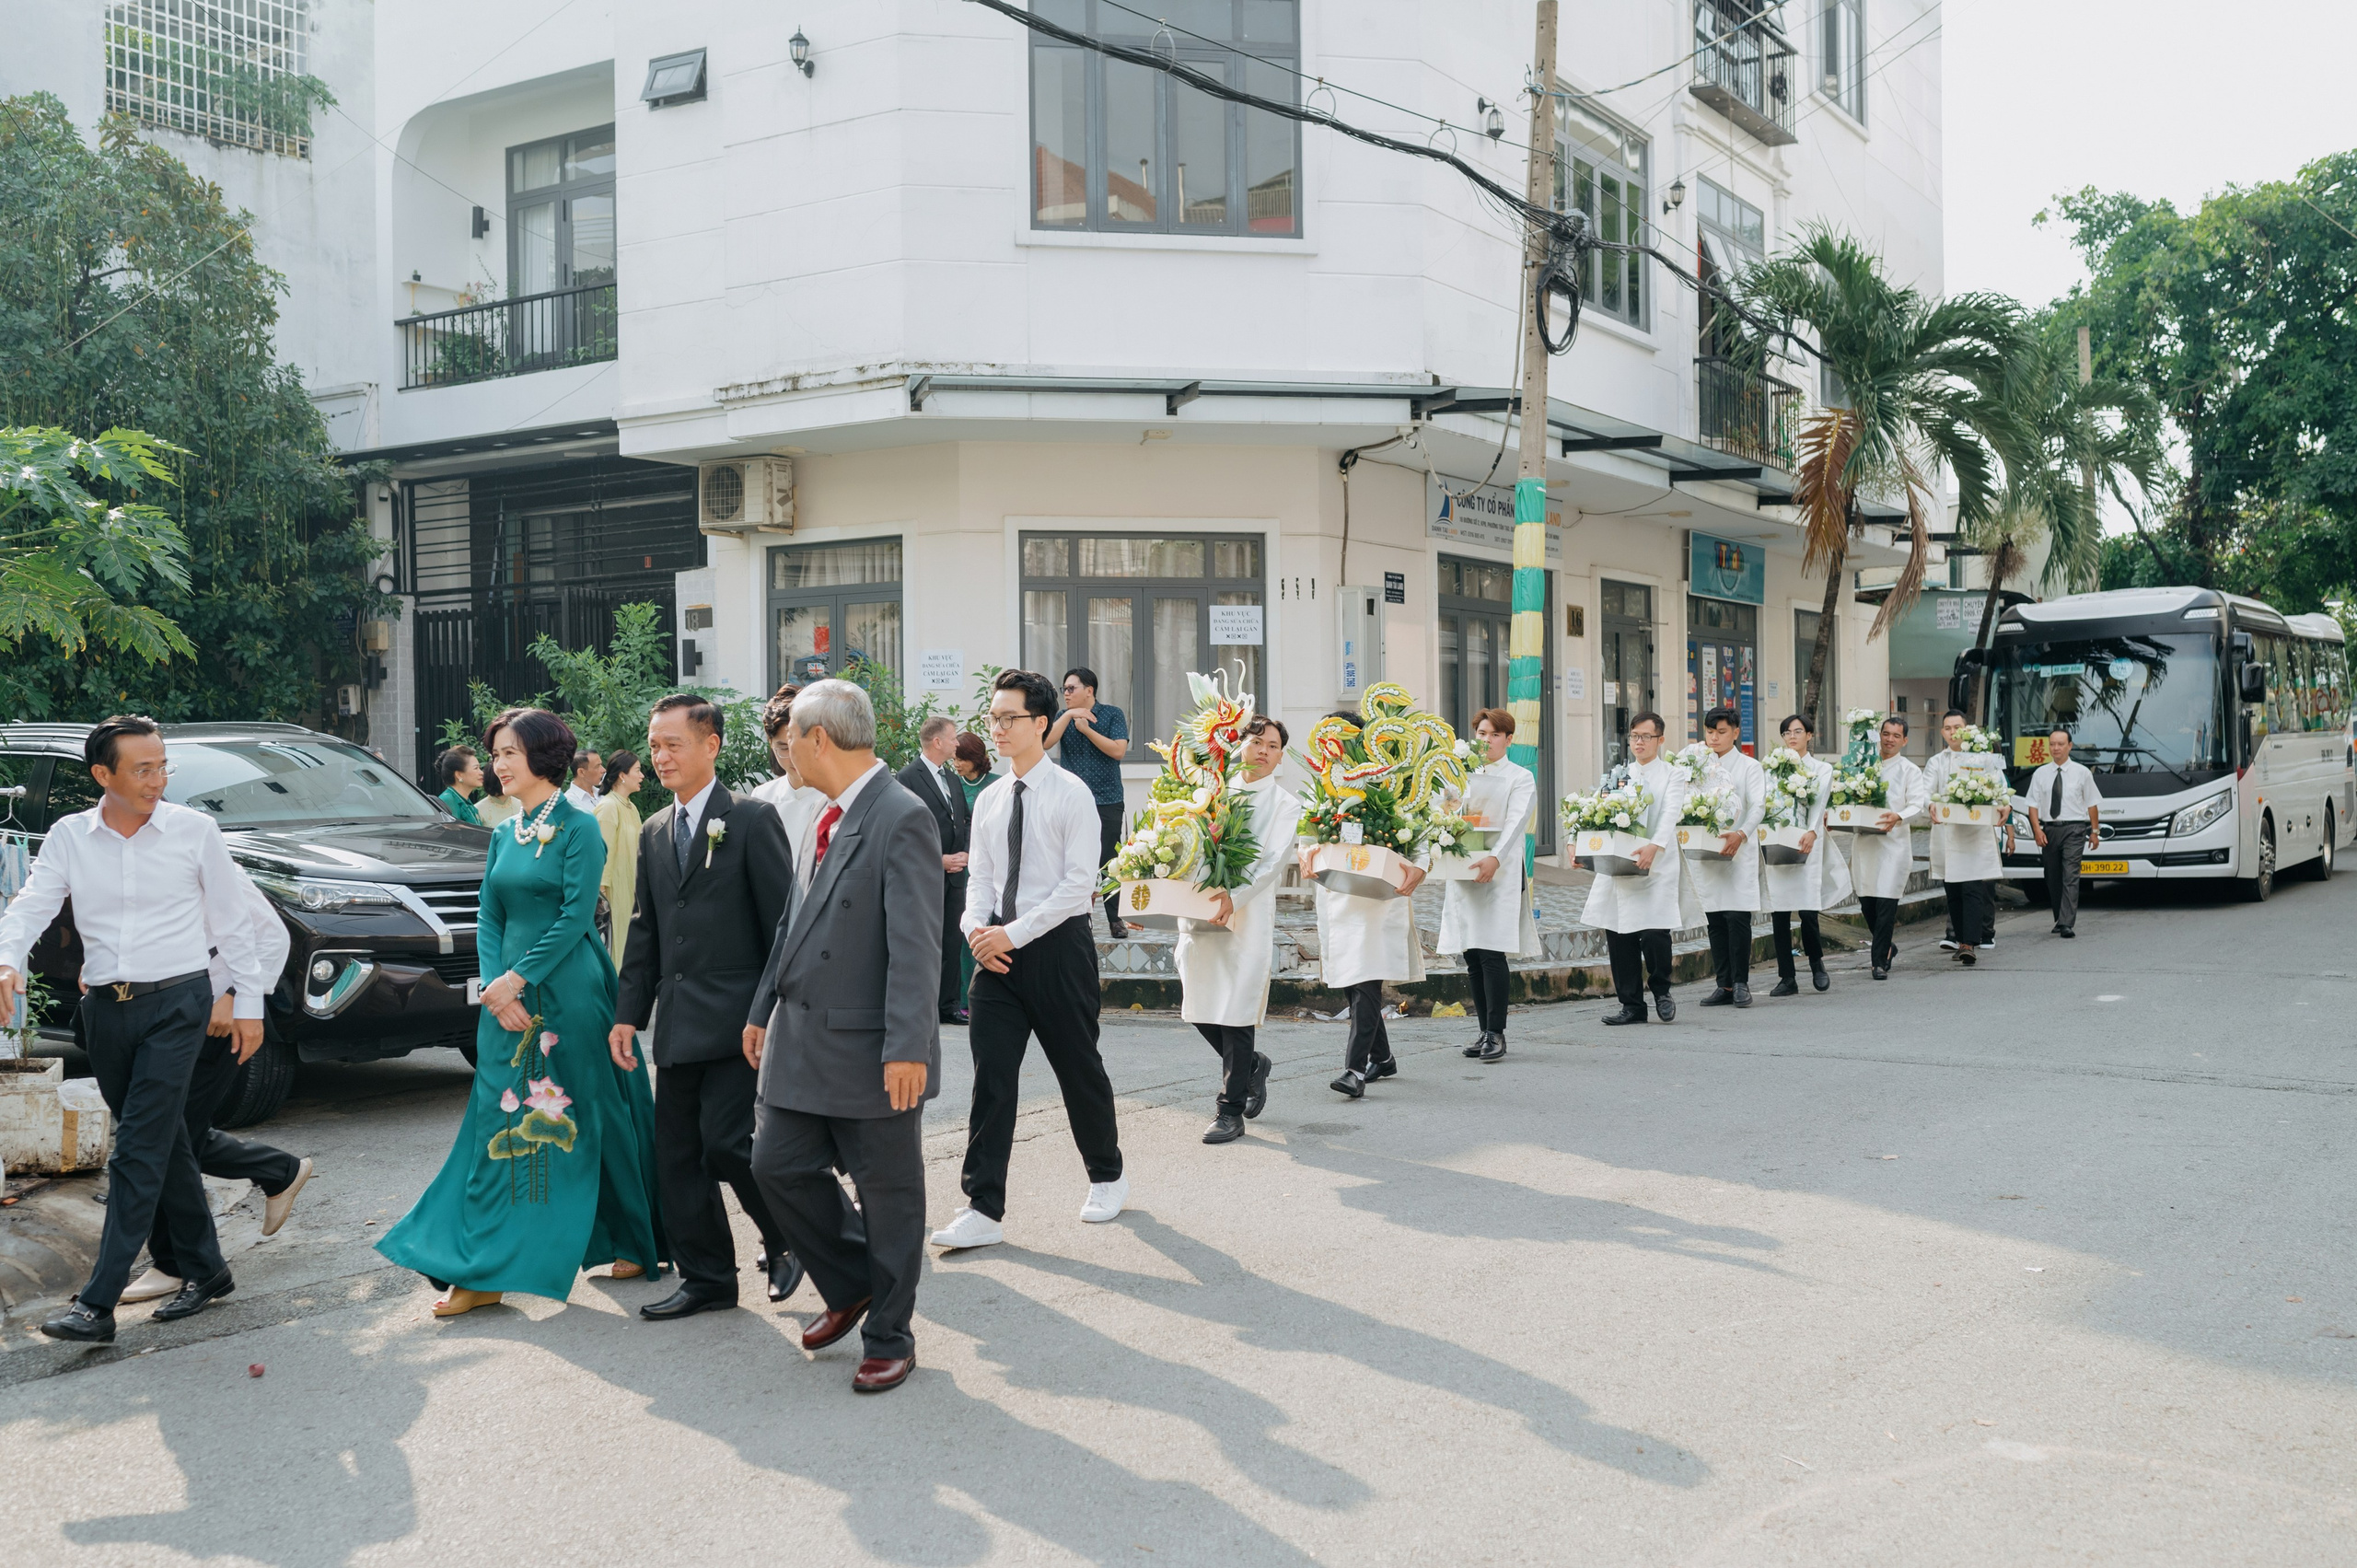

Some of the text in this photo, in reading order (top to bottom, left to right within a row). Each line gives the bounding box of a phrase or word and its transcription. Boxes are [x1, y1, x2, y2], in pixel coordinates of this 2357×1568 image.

[1457, 489, 1475, 510] CÔNG
[1477, 497, 1485, 512] TY
[1487, 492, 1496, 515] CỔ
[1546, 511, 1561, 527] LAND
[686, 612, 699, 632] 18
[1571, 610, 1582, 627] 16
